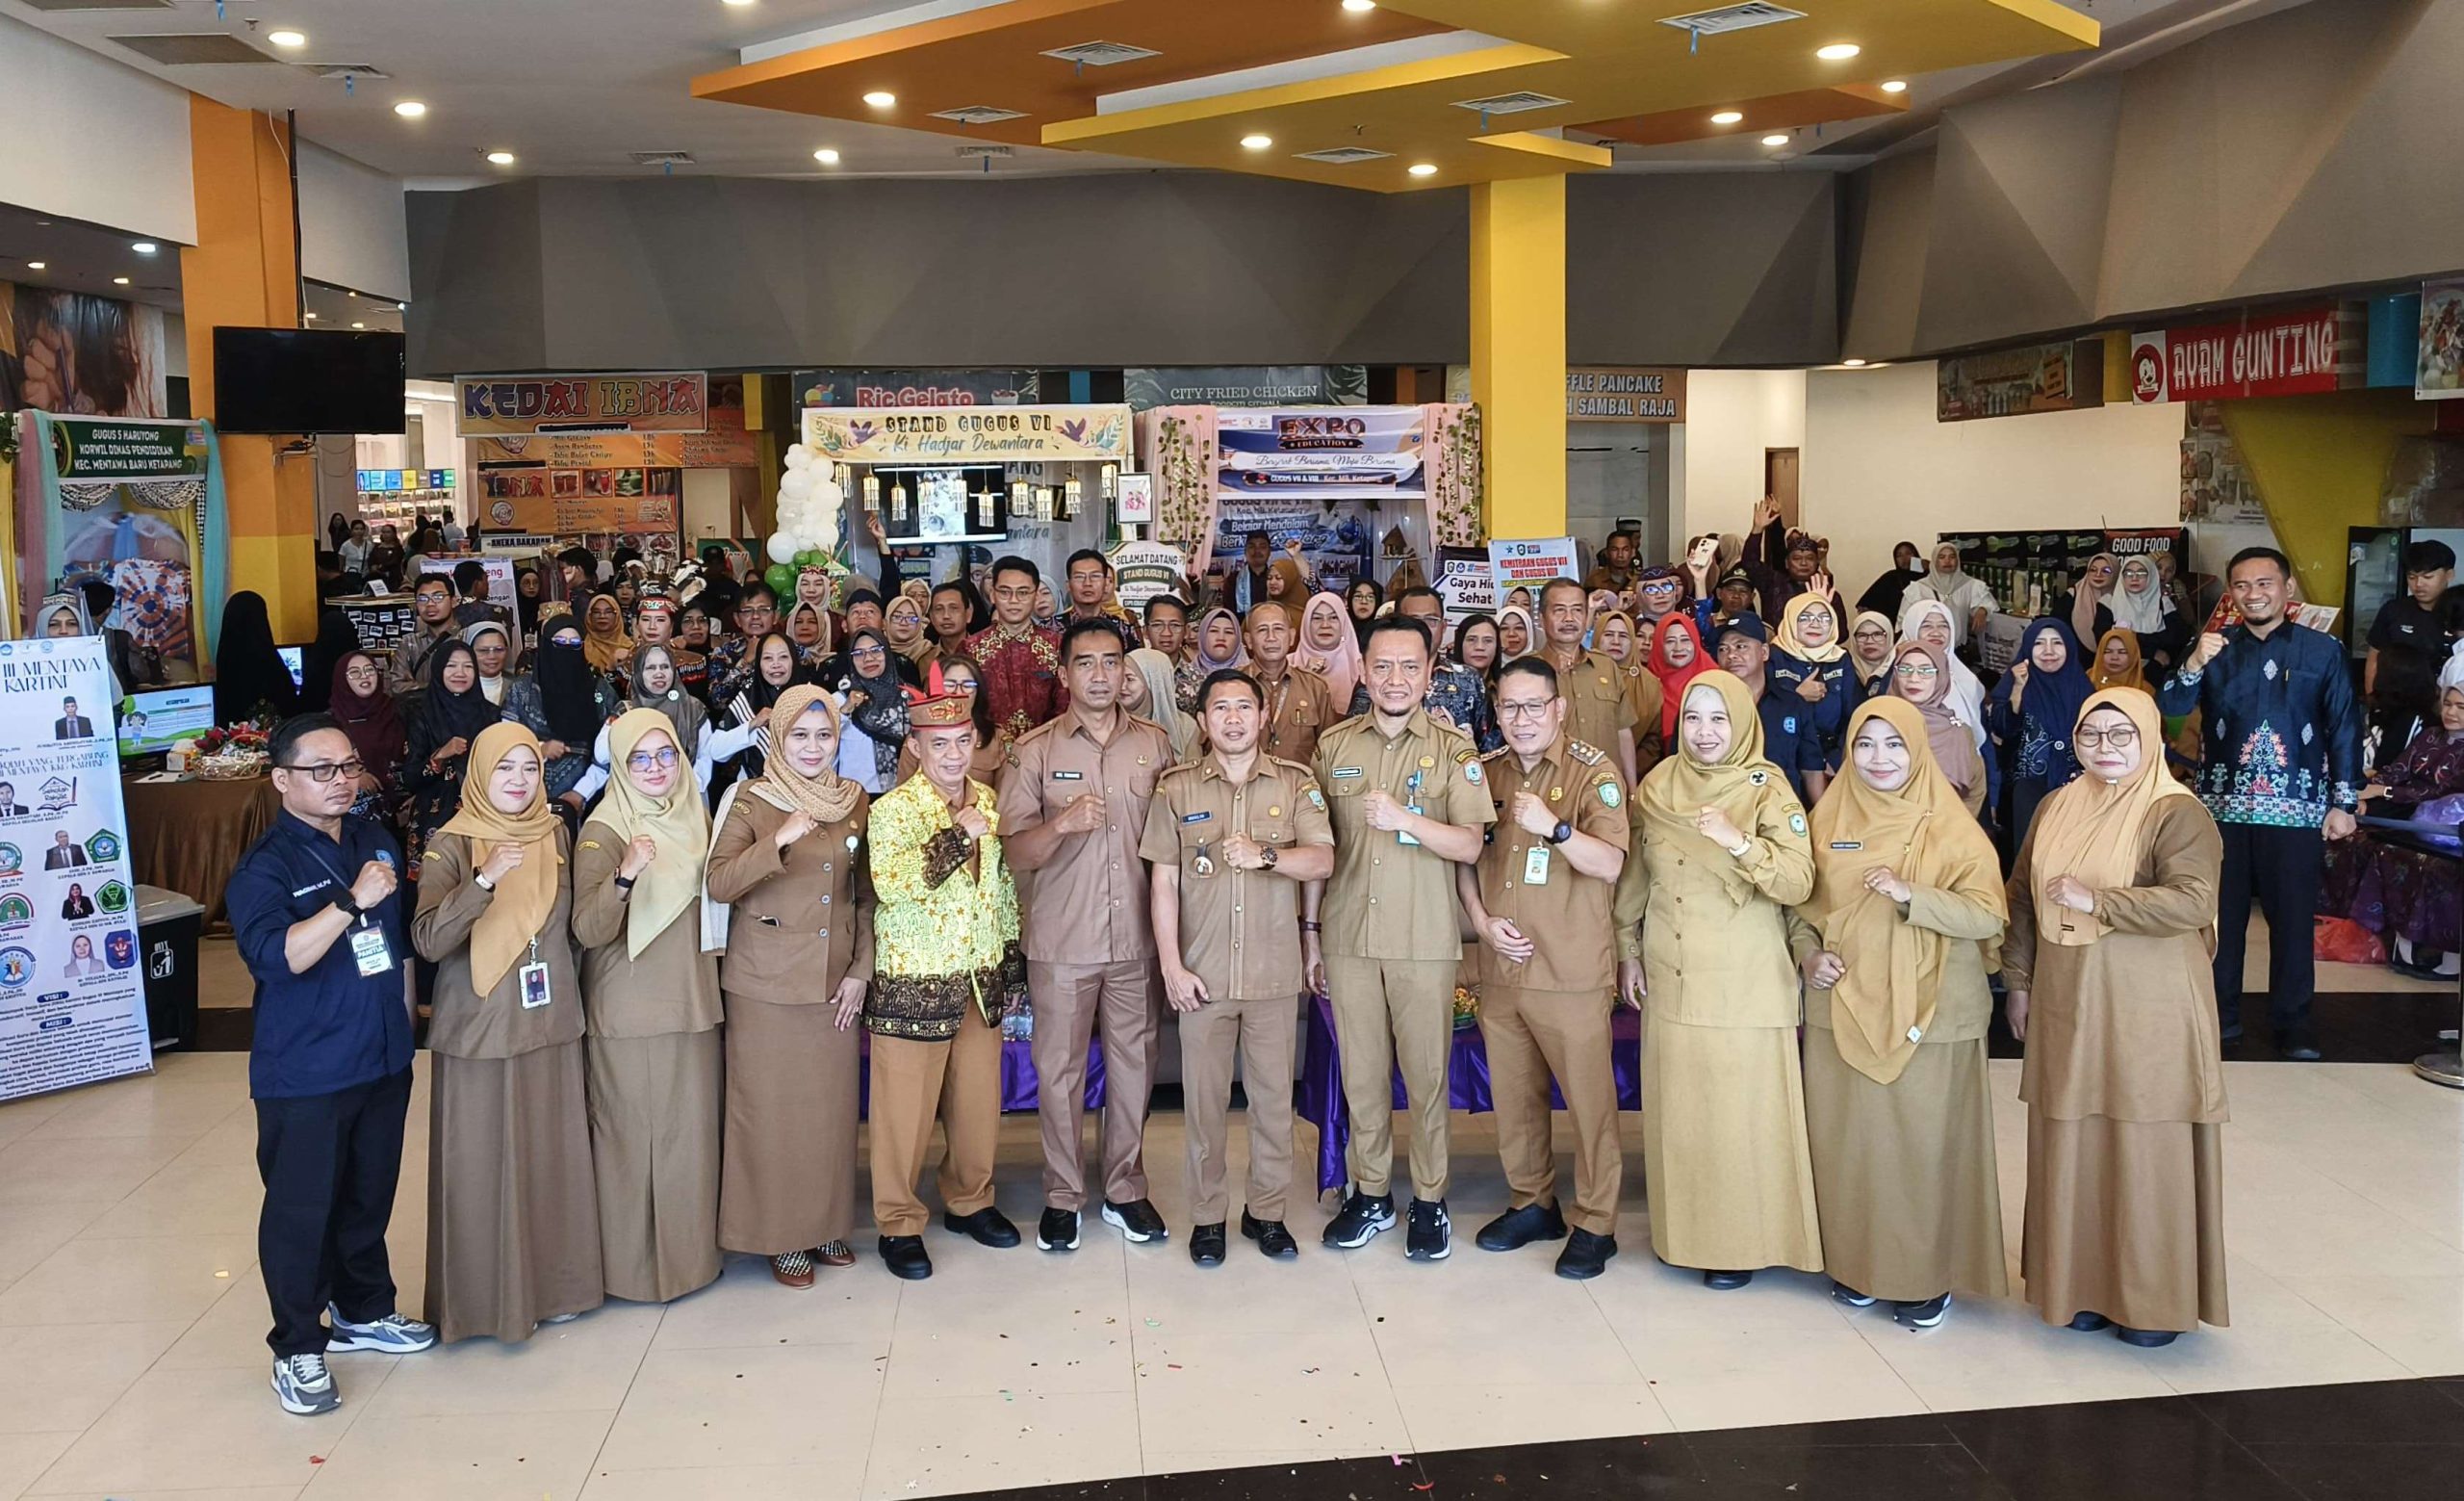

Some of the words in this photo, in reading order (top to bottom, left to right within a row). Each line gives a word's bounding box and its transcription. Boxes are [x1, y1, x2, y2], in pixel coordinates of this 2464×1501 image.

[2173, 338, 2225, 391] AYAM
[2232, 320, 2334, 383] GUNTING
[1599, 375, 1663, 393] PANCAKE
[464, 380, 589, 418] KEDAI
[600, 377, 701, 416] IBNA
[896, 387, 974, 406] Gelato
[1170, 387, 1203, 400] CITY
[1206, 386, 1250, 399] FRIED
[1253, 385, 1318, 398] CHICKEN
[1578, 398, 1634, 416] SAMBAL
[1638, 399, 1676, 417] RAJA
[886, 416, 947, 432] STAND
[958, 415, 1019, 431] GUGUS
[1029, 414, 1052, 431] VI
[1279, 417, 1366, 437] EXPO
[91, 429, 117, 440] GUGUS
[123, 430, 159, 441] HARUYONG
[79, 444, 108, 455] KORWIL
[109, 445, 131, 455] DINAS
[132, 445, 173, 455] PENDIDIKAN
[892, 434, 909, 452] Ki
[917, 432, 963, 456] Hadjar
[971, 432, 1044, 452] Dewantara
[1297, 440, 1348, 449] EDUCATION
[74, 459, 91, 470] KEC.
[129, 459, 147, 470] BARU
[147, 459, 183, 470] KETAPANG
[1264, 519, 1309, 531] Mendalam
[491, 539, 516, 548] ANEKA
[2112, 537, 2143, 553] GOOD
[2143, 537, 2170, 552] FOOD
[1116, 554, 1148, 565] SELAMAT
[1149, 554, 1178, 565] DATANG
[1500, 557, 1535, 569] KEMITRAAN
[1535, 556, 1557, 567] GUGUS
[1123, 568, 1142, 580] STAND
[1143, 568, 1163, 579] GUGUS
[1525, 568, 1547, 578] GUGUS
[1450, 578, 1476, 590] Gaya
[1458, 592, 1492, 605] Sehat
[23, 657, 101, 676] MENTAYA
[5, 675, 67, 693] KARTINI
[43, 993, 60, 1001] VISI
[46, 1019, 64, 1027] MISI
